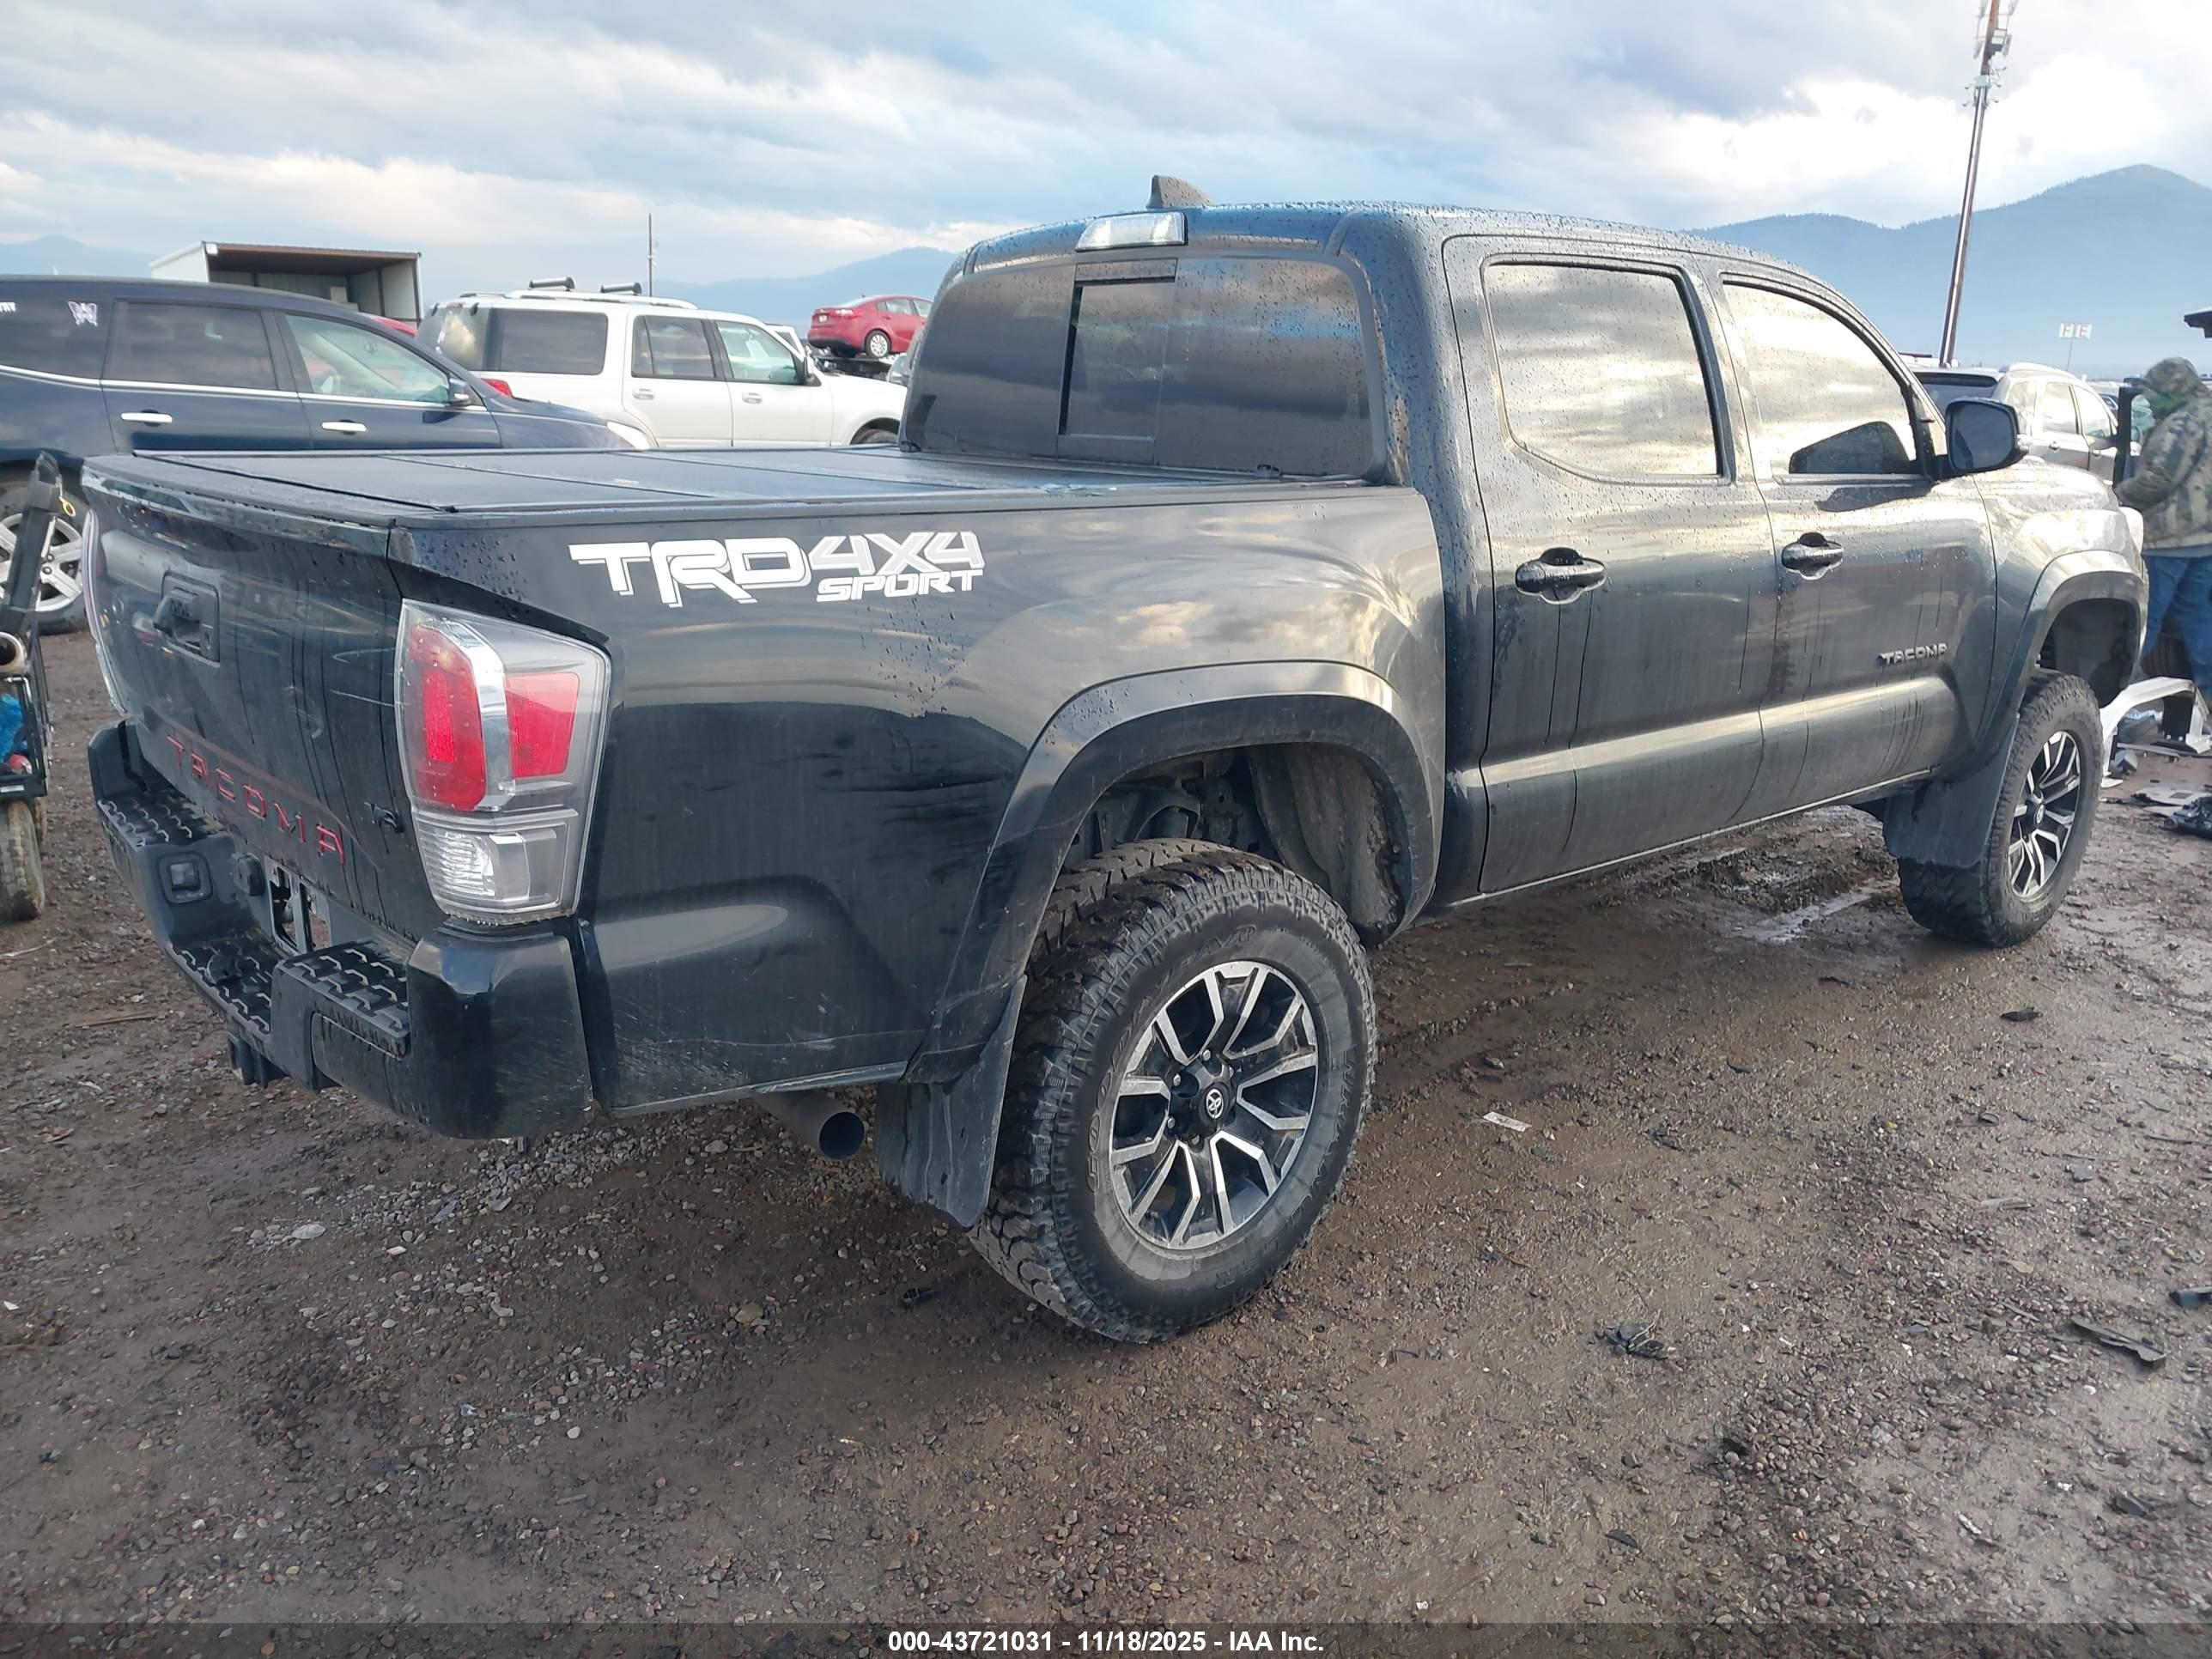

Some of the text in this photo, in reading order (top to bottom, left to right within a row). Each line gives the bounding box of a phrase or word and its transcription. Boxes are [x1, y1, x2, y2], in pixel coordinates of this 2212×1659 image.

[568, 538, 811, 608] TRD
[817, 568, 984, 603] SPORT
[1880, 642, 1948, 665] TACOMA
[167, 734, 347, 866] TACOMA
